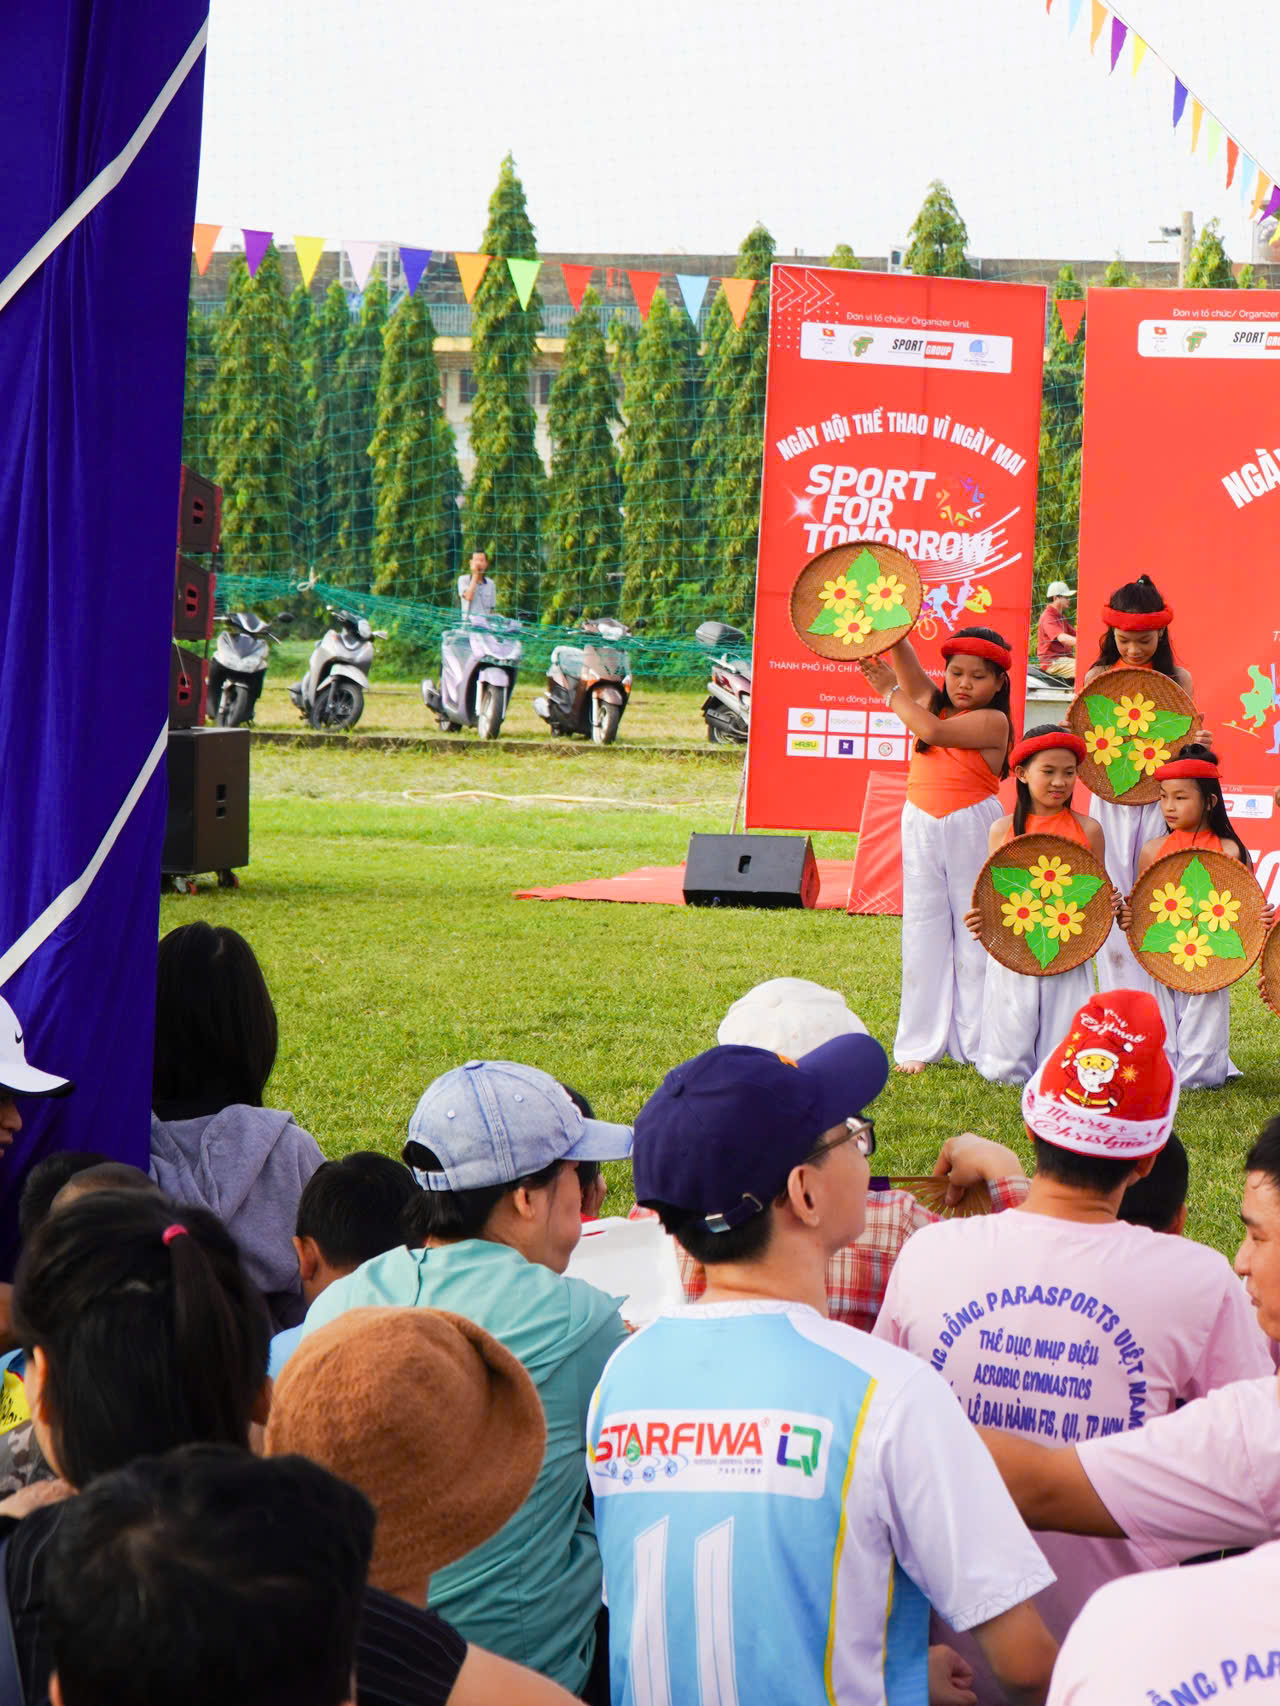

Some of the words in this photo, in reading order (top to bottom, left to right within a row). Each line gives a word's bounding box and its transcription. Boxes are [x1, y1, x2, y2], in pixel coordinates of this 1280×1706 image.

[912, 317, 950, 327] Organizer
[953, 320, 969, 328] Unit
[1173, 309, 1190, 318] Đơn
[1239, 309, 1279, 319] Organizer
[892, 339, 923, 351] SPORT
[926, 345, 952, 355] GROUP
[1233, 331, 1264, 343] SPORT
[776, 426, 820, 461] NGÀY
[821, 414, 850, 442] HỘI
[852, 406, 884, 434] THỂ
[888, 412, 928, 434] THAO
[933, 415, 951, 438] VÌ
[950, 424, 994, 456] NGÀY
[991, 443, 1026, 476] MAI
[805, 464, 936, 500] SPORT
[823, 496, 893, 528] FOR
[1045, 1105, 1112, 1134] Merry
[939, 1301, 985, 1348] ĐỒNG
[986, 1284, 1120, 1333] PARASPORTS
[1006, 1334, 1032, 1360] DỤC
[1034, 1339, 1066, 1366] NHỊP
[1068, 1339, 1099, 1369] ĐIỆU
[1114, 1328, 1145, 1375] VIỆT
[973, 1363, 1021, 1390] AEROBIC
[1022, 1371, 1092, 1400] GYMNASTICS
[967, 1393, 982, 1425] LÊ
[1004, 1398, 1037, 1433] HÀNH
[1086, 1415, 1099, 1440] TP
[1128, 1381, 1147, 1430] NAM
[594, 1422, 763, 1465] STARFIWA
